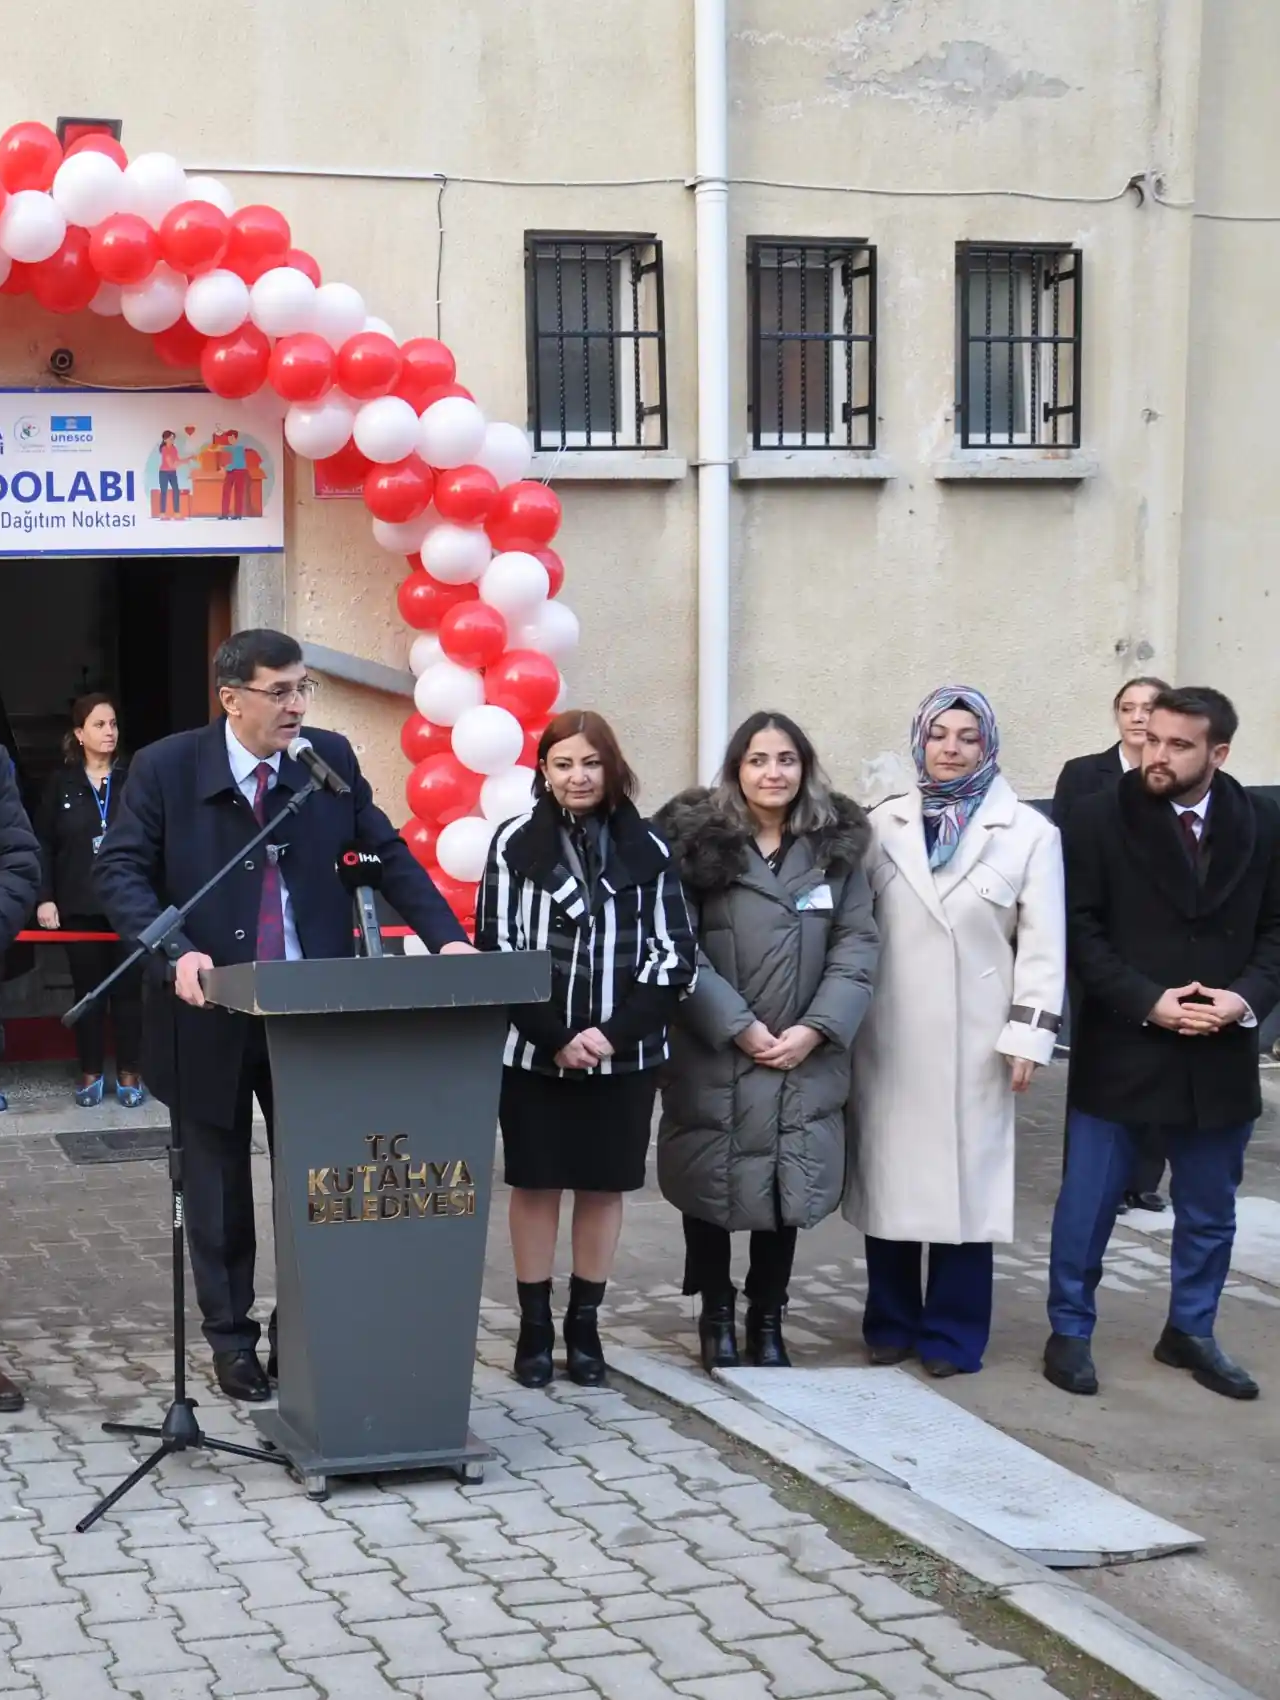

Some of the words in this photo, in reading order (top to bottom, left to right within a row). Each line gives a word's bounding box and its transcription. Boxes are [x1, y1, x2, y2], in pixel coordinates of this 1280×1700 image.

[50, 432, 93, 443] unesco
[0, 510, 66, 533] Dağıtım
[72, 511, 136, 528] Noktası
